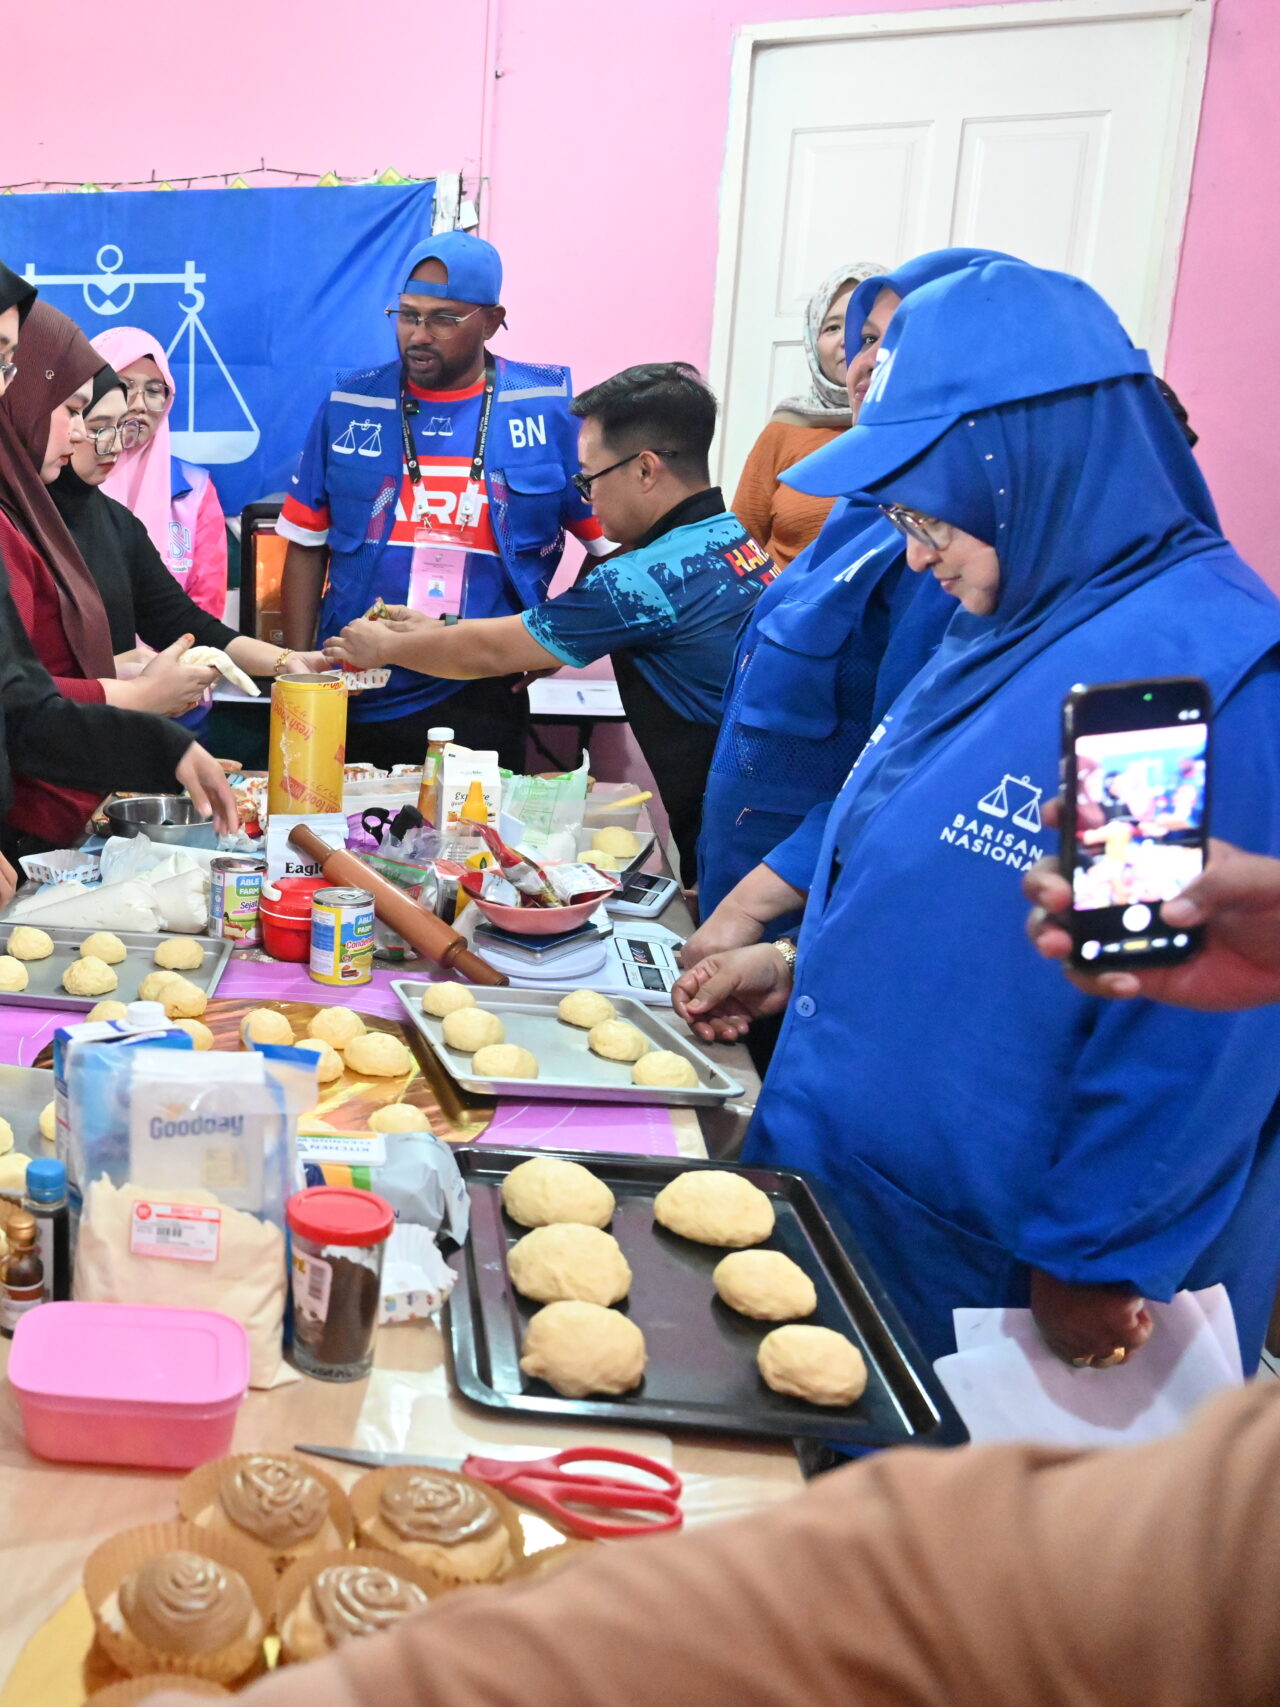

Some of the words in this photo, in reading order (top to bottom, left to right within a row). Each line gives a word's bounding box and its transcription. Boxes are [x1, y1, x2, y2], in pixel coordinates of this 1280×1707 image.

[508, 414, 547, 448] BN
[940, 826, 1033, 872] NASIONA
[952, 813, 1043, 861] BARISAN
[239, 877, 260, 886] ABLE
